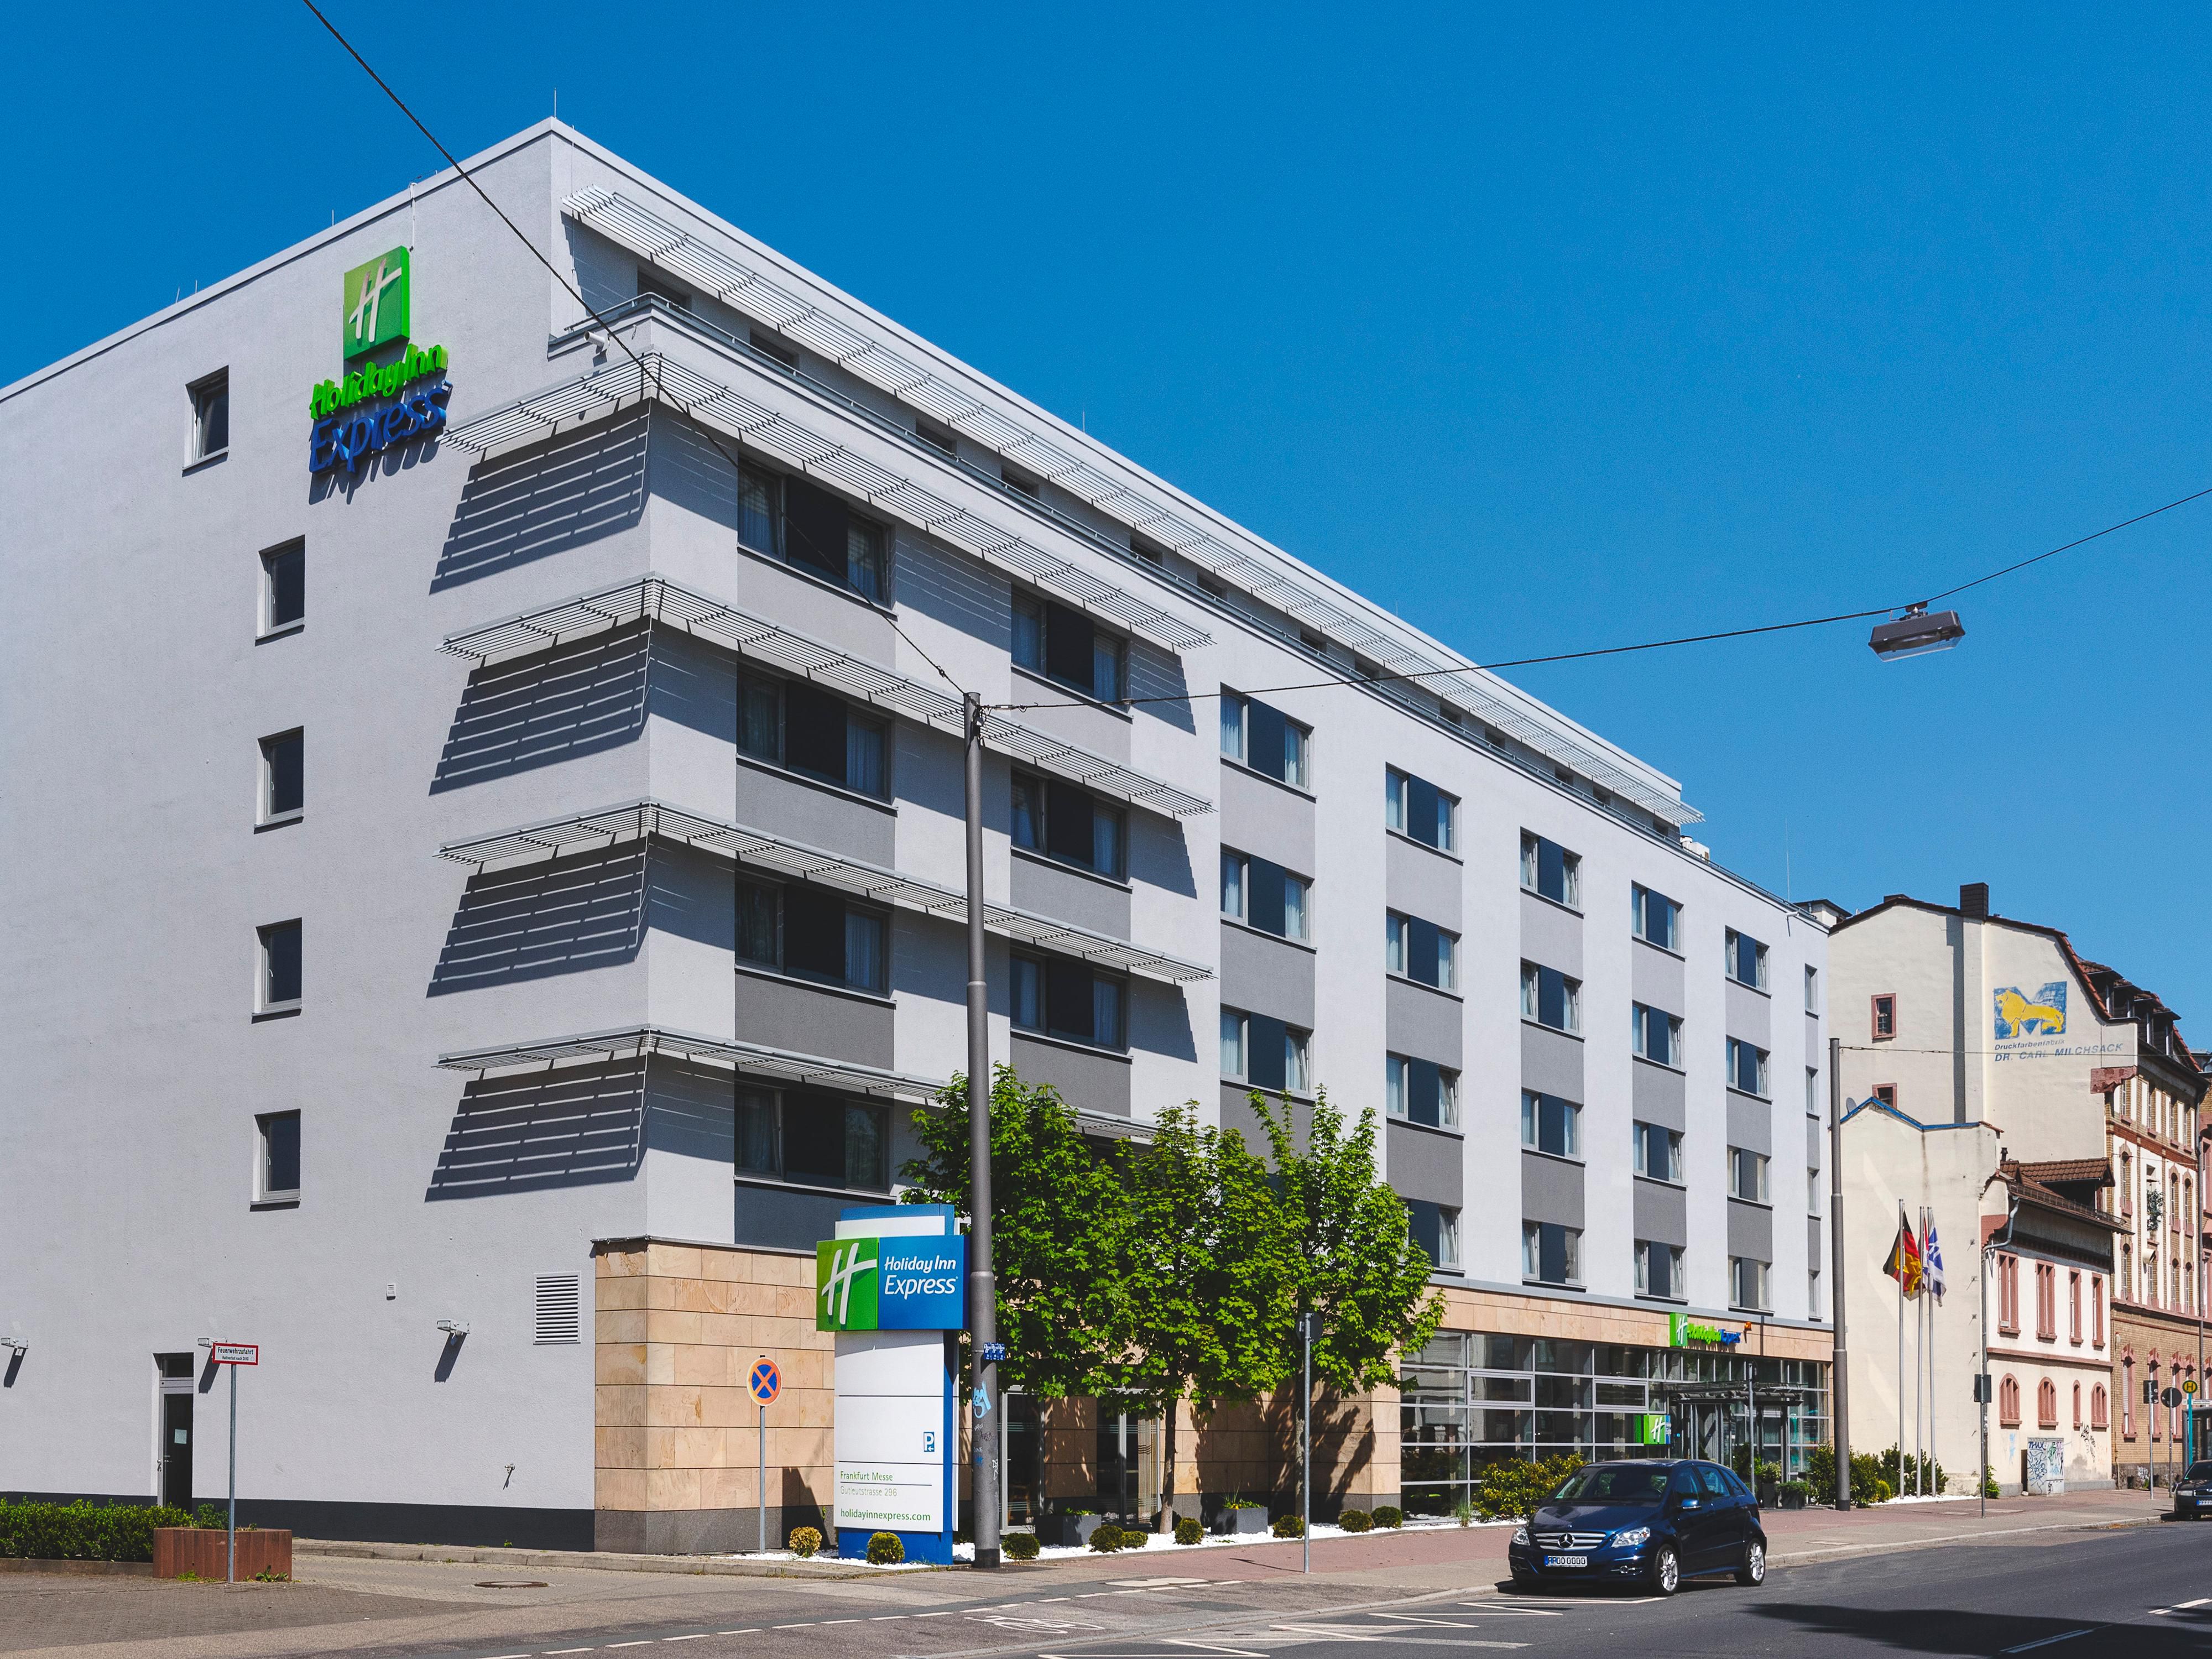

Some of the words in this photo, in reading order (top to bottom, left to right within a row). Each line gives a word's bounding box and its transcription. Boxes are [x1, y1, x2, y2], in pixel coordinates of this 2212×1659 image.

[310, 361, 406, 420] Holiday
[404, 343, 448, 382] Inn
[310, 387, 447, 474] Express
[1995, 1039, 2065, 1050] Druckfarbenfabrik
[2019, 1050, 2048, 1060] CARL
[2054, 1043, 2124, 1057] MILCHSACK
[884, 1256, 933, 1274] Holiday
[934, 1255, 957, 1270] Inn
[884, 1274, 957, 1300] Express
[217, 1347, 254, 1355] Feuerwehrzufahrt
[840, 1470, 870, 1481] Frankfurt
[872, 1472, 894, 1481] Messe
[840, 1485, 883, 1496] Gutleutstrasse
[884, 1488, 898, 1497] 296
[841, 1508, 931, 1521] holidayinnexpress.com
